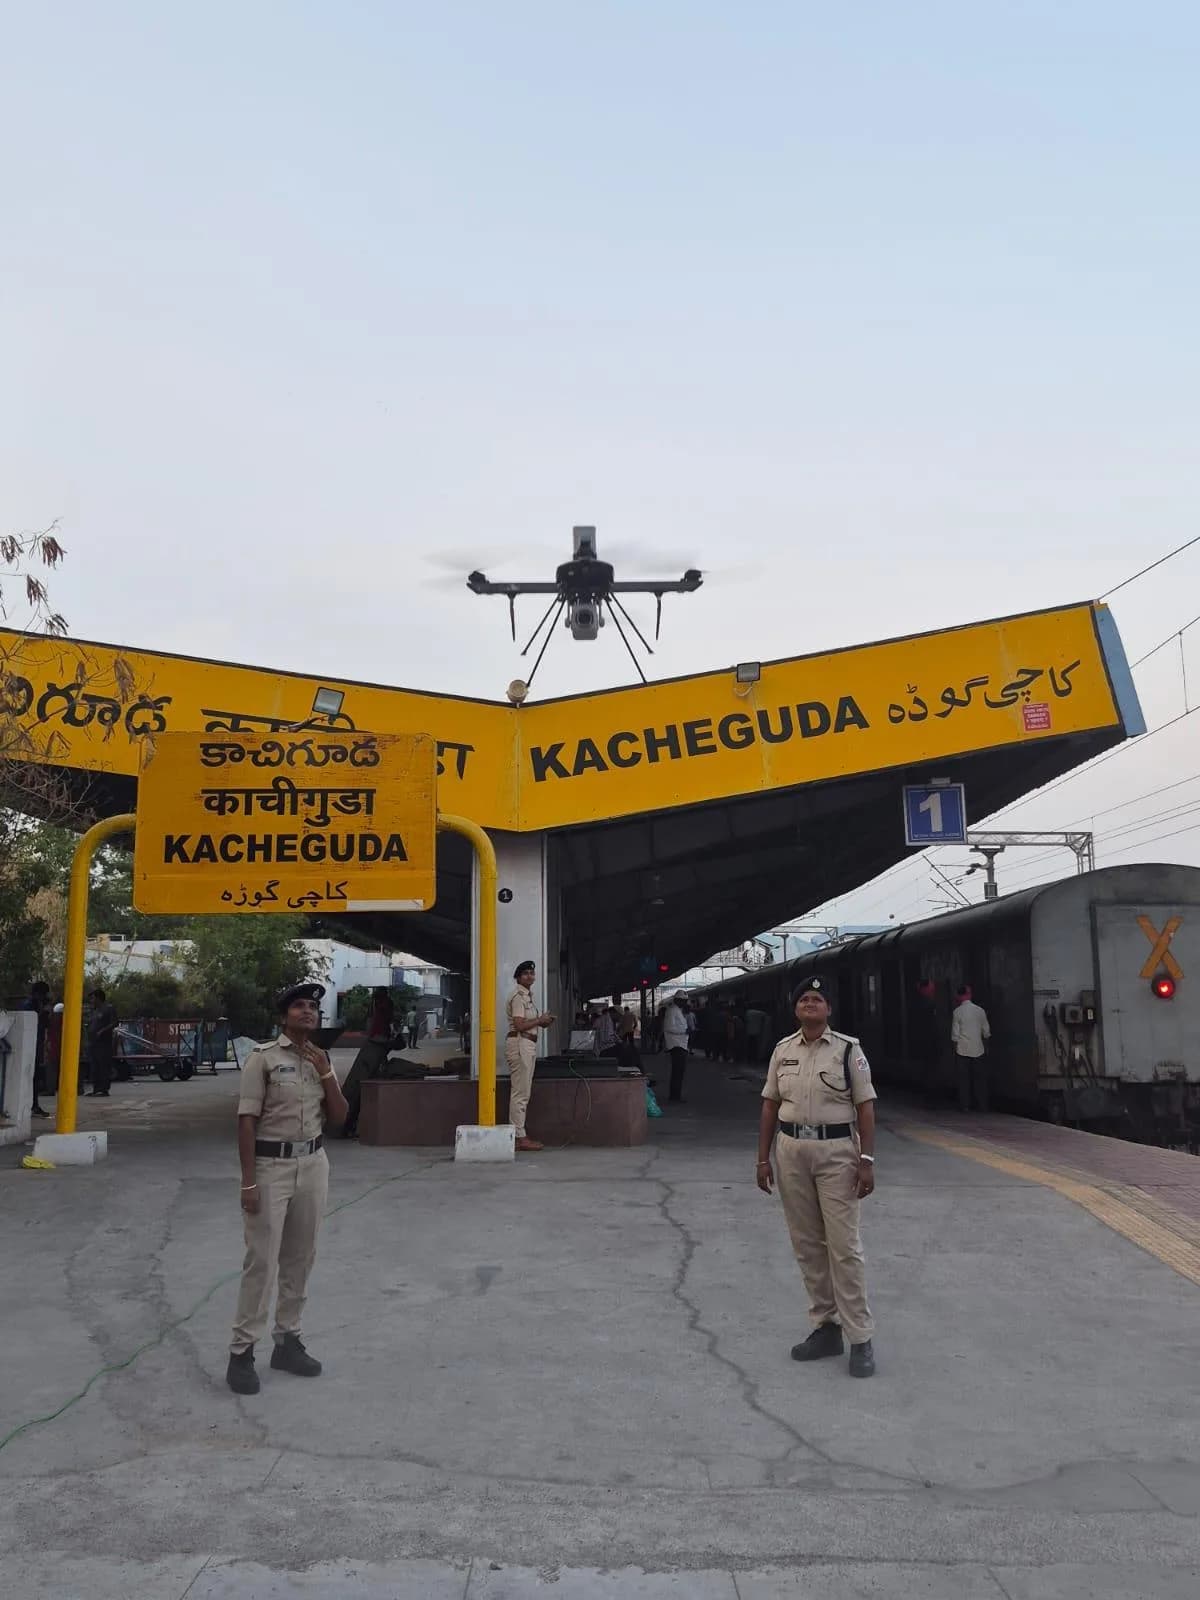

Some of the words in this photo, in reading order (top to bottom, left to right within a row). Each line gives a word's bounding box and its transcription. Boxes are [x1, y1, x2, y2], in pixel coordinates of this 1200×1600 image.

[200, 738, 381, 768] కాచిగూడ
[529, 694, 870, 783] KACHEGUDA
[201, 775, 377, 827] काचीगुडा
[919, 791, 943, 833] 1
[164, 833, 409, 864] KACHEGUDA
